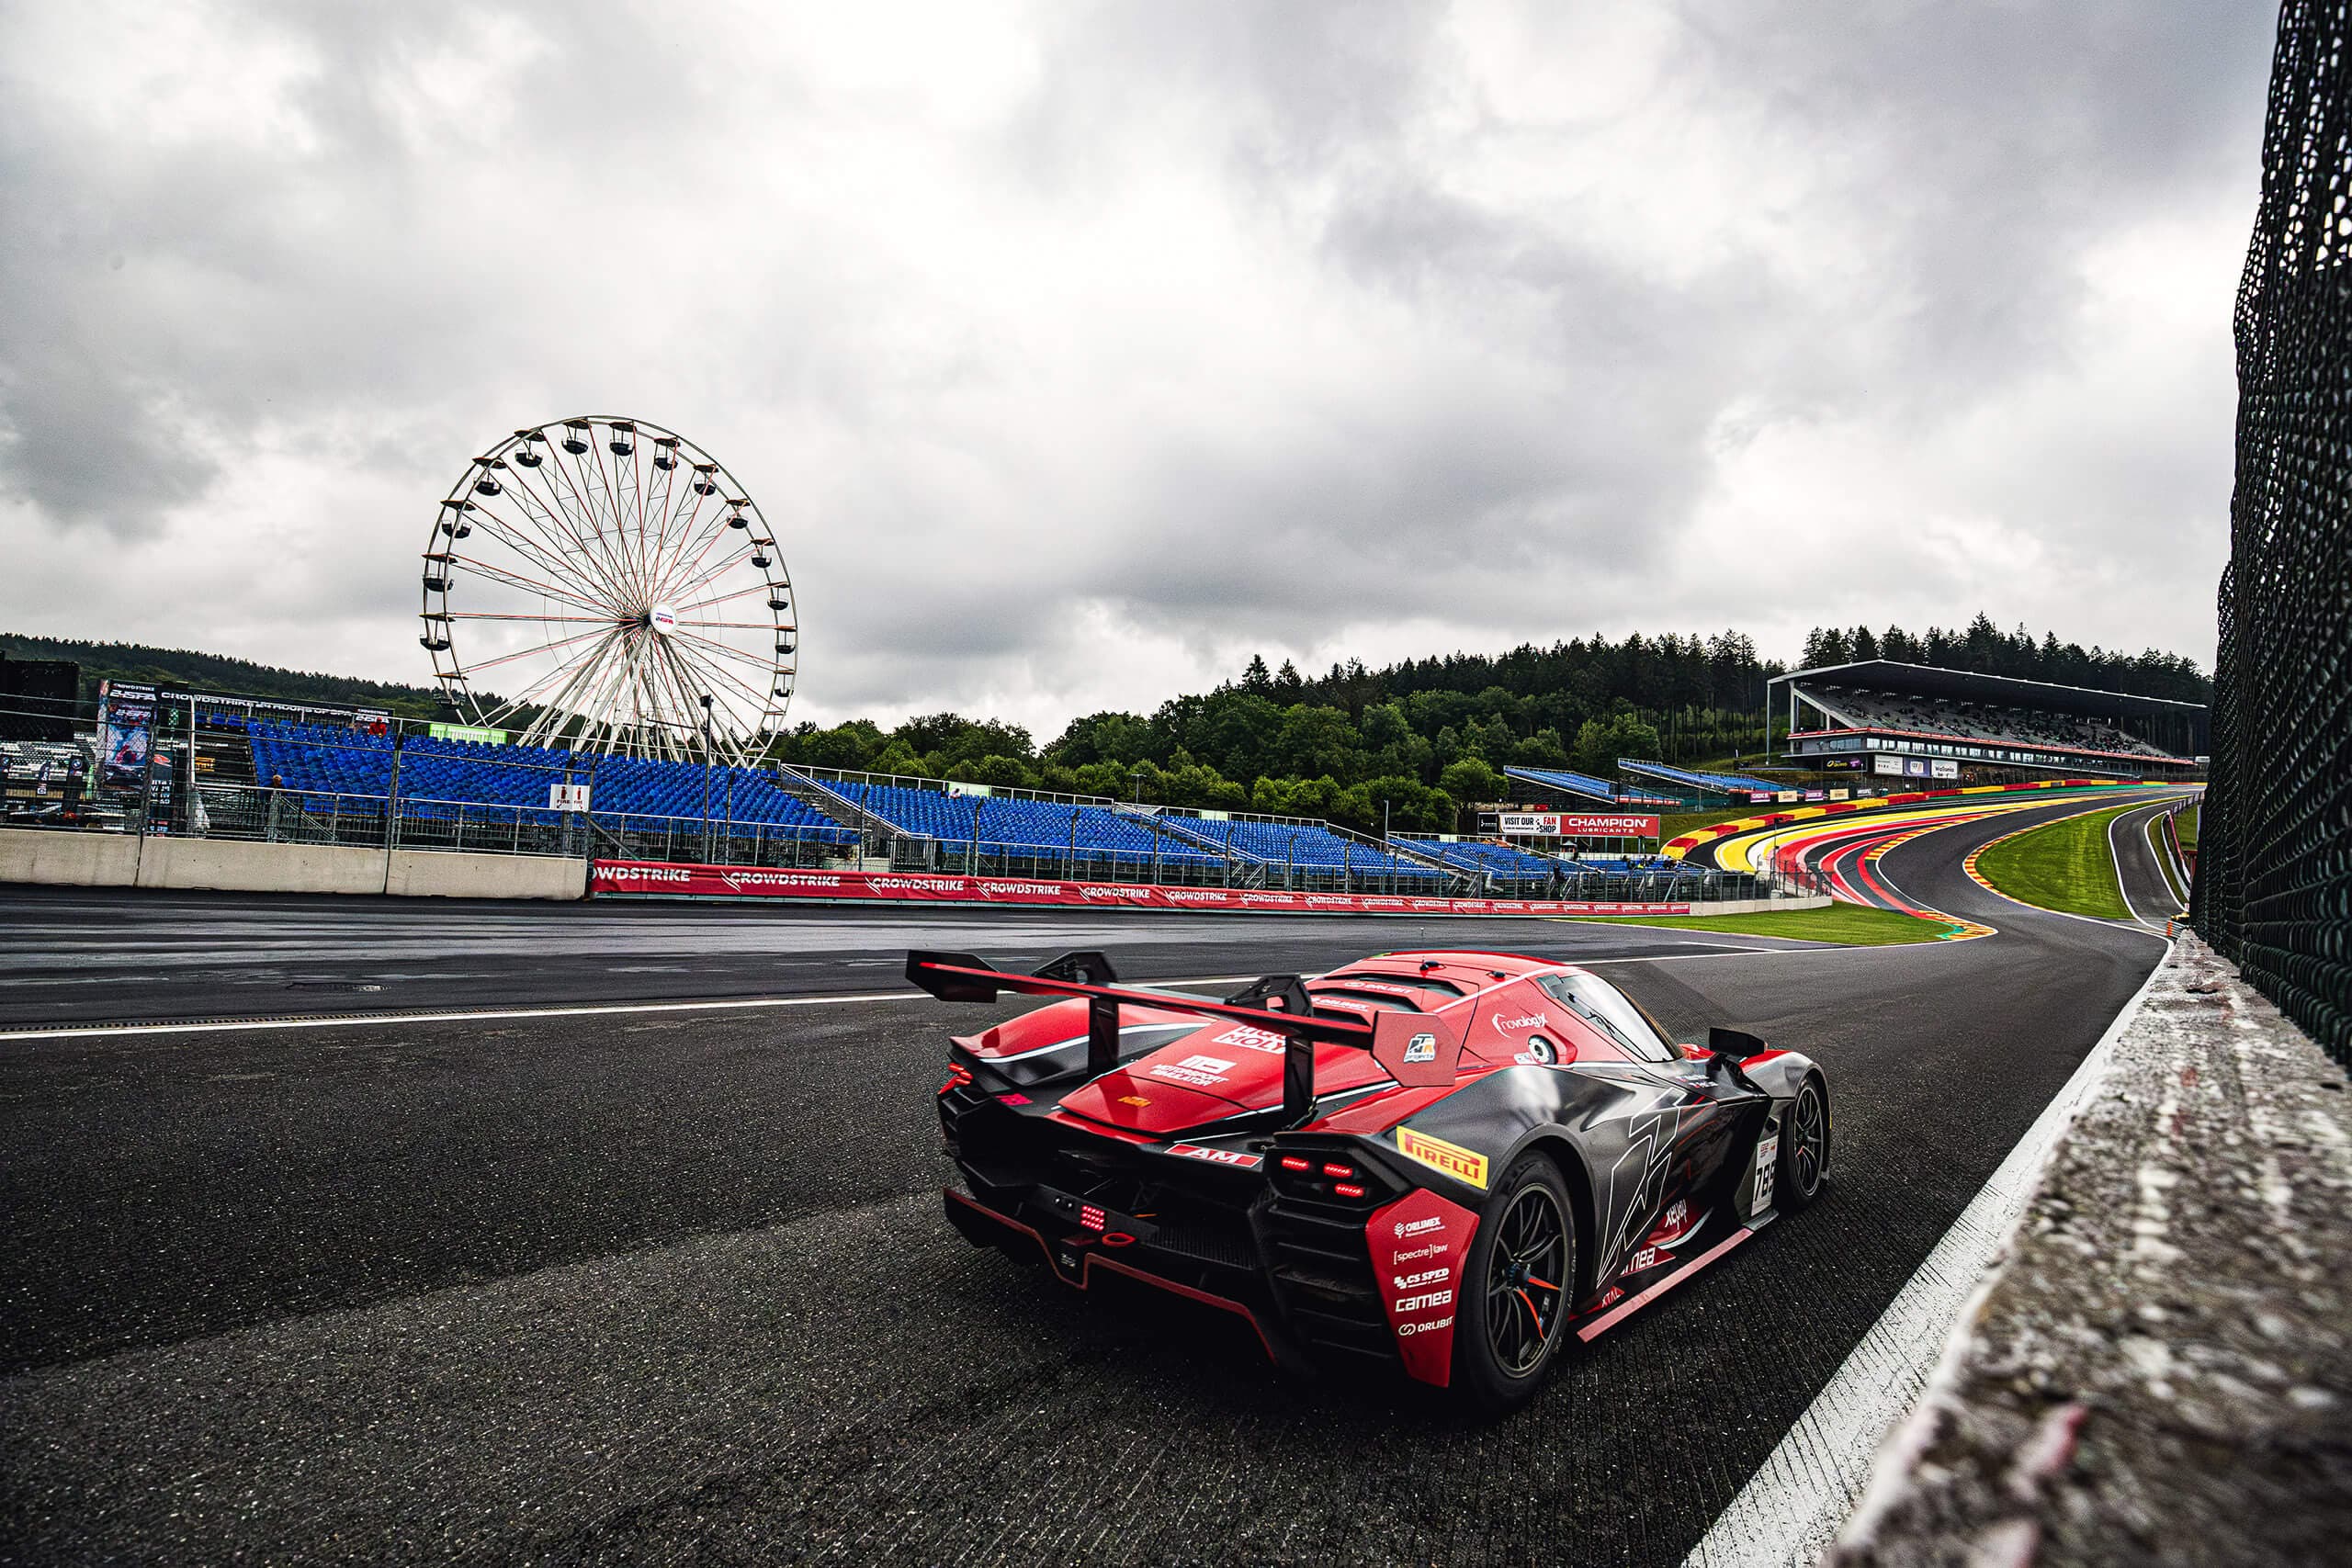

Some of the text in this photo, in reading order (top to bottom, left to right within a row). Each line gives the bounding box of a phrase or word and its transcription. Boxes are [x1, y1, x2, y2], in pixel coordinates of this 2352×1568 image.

[1504, 816, 1556, 826] VISIT OUR FAN
[1568, 818, 1646, 828] CHAMPION
[1539, 825, 1556, 833] SHOP
[732, 872, 841, 887] CROWDSTRIKE
[873, 876, 965, 891] CROWDSTRIKE
[982, 882, 1061, 896] CROWDSTRIKE
[1085, 886, 1150, 899] CROWDSTRIKE
[1169, 890, 1227, 901] CROWDSTRIKE
[1243, 893, 1295, 903] CROWDSTRIKE
[1219, 1034, 1285, 1051] MOLY
[1184, 1147, 1243, 1164] AM
[1405, 1133, 1481, 1179] PIRELLI
[1406, 1216, 1441, 1232] ORLIMEX
[1407, 1273, 1420, 1283] CS
[1421, 1268, 1450, 1281] SPED
[1396, 1289, 1453, 1313] camea
[1418, 1315, 1453, 1333] ORLIBIT
